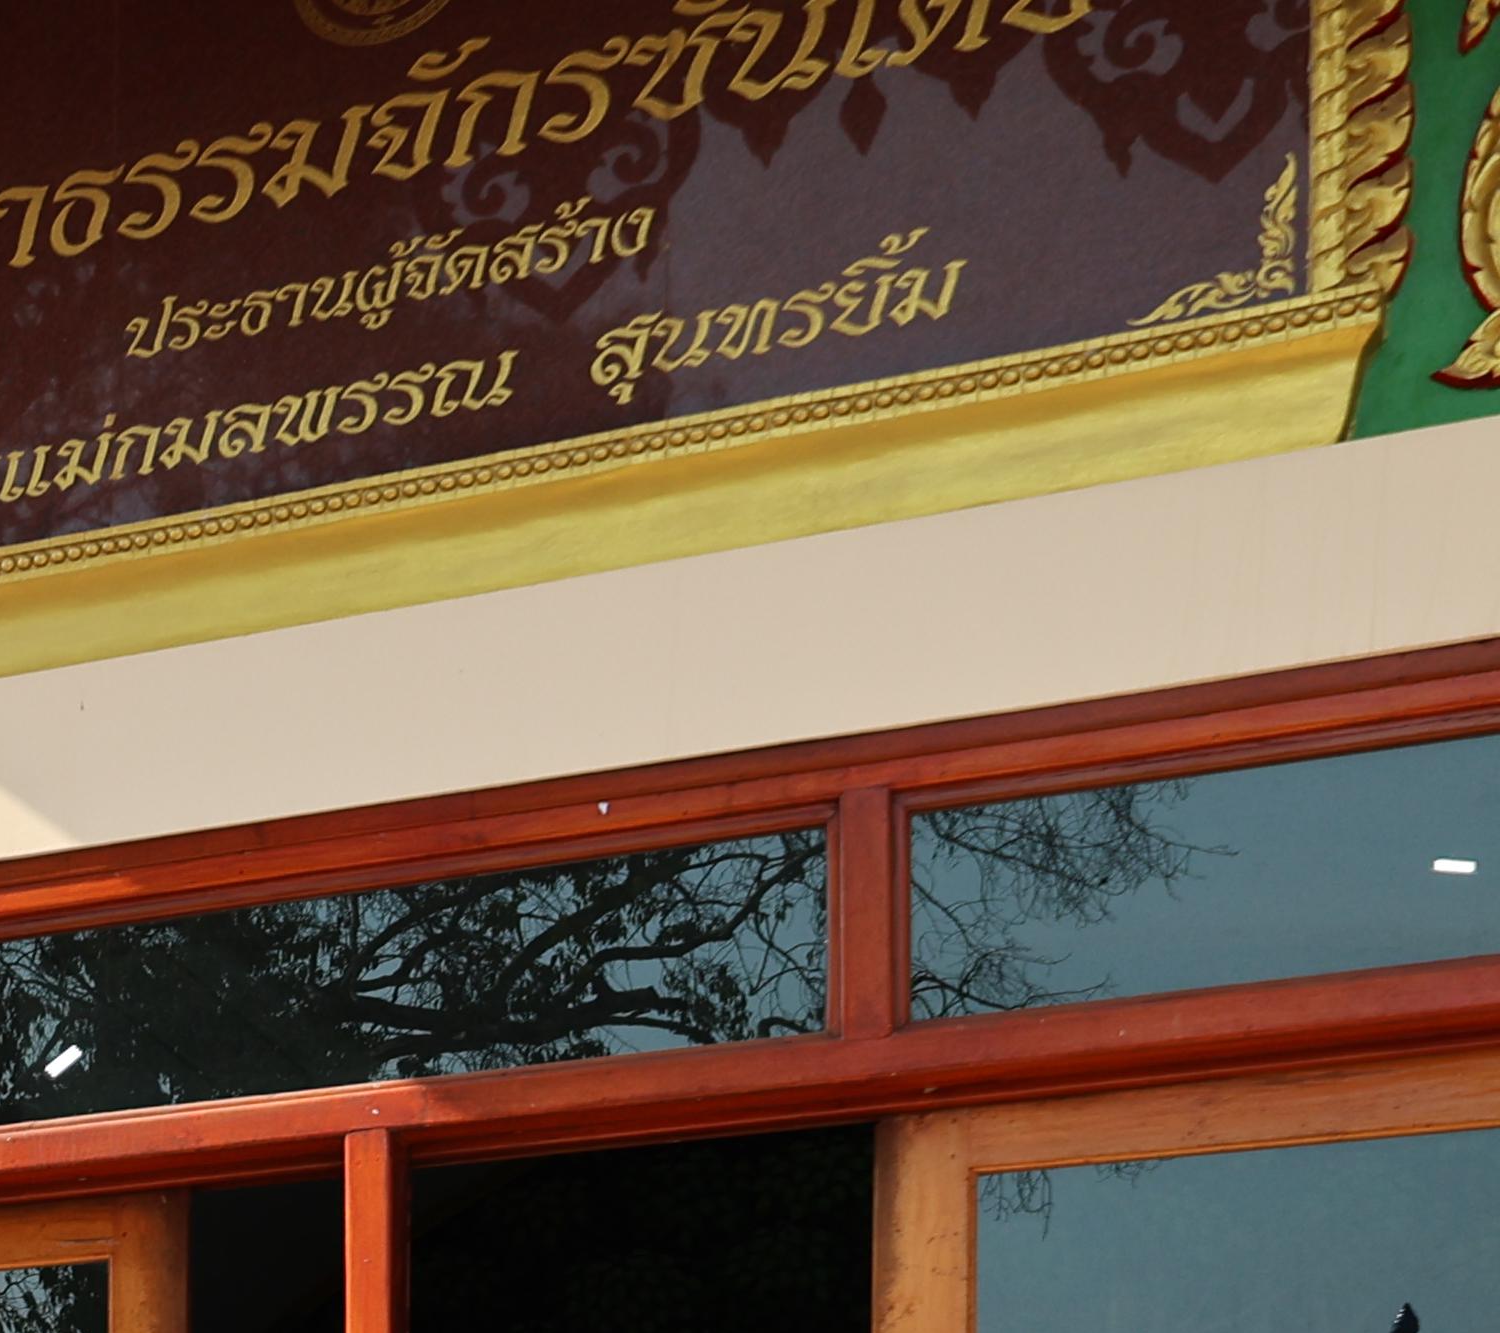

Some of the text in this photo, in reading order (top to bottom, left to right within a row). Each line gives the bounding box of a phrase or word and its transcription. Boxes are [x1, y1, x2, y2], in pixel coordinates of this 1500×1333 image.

[125, 196, 656, 358] ประธานผู้จัดสร้าง
[589, 228, 967, 405] สุนทรยิ้ม
